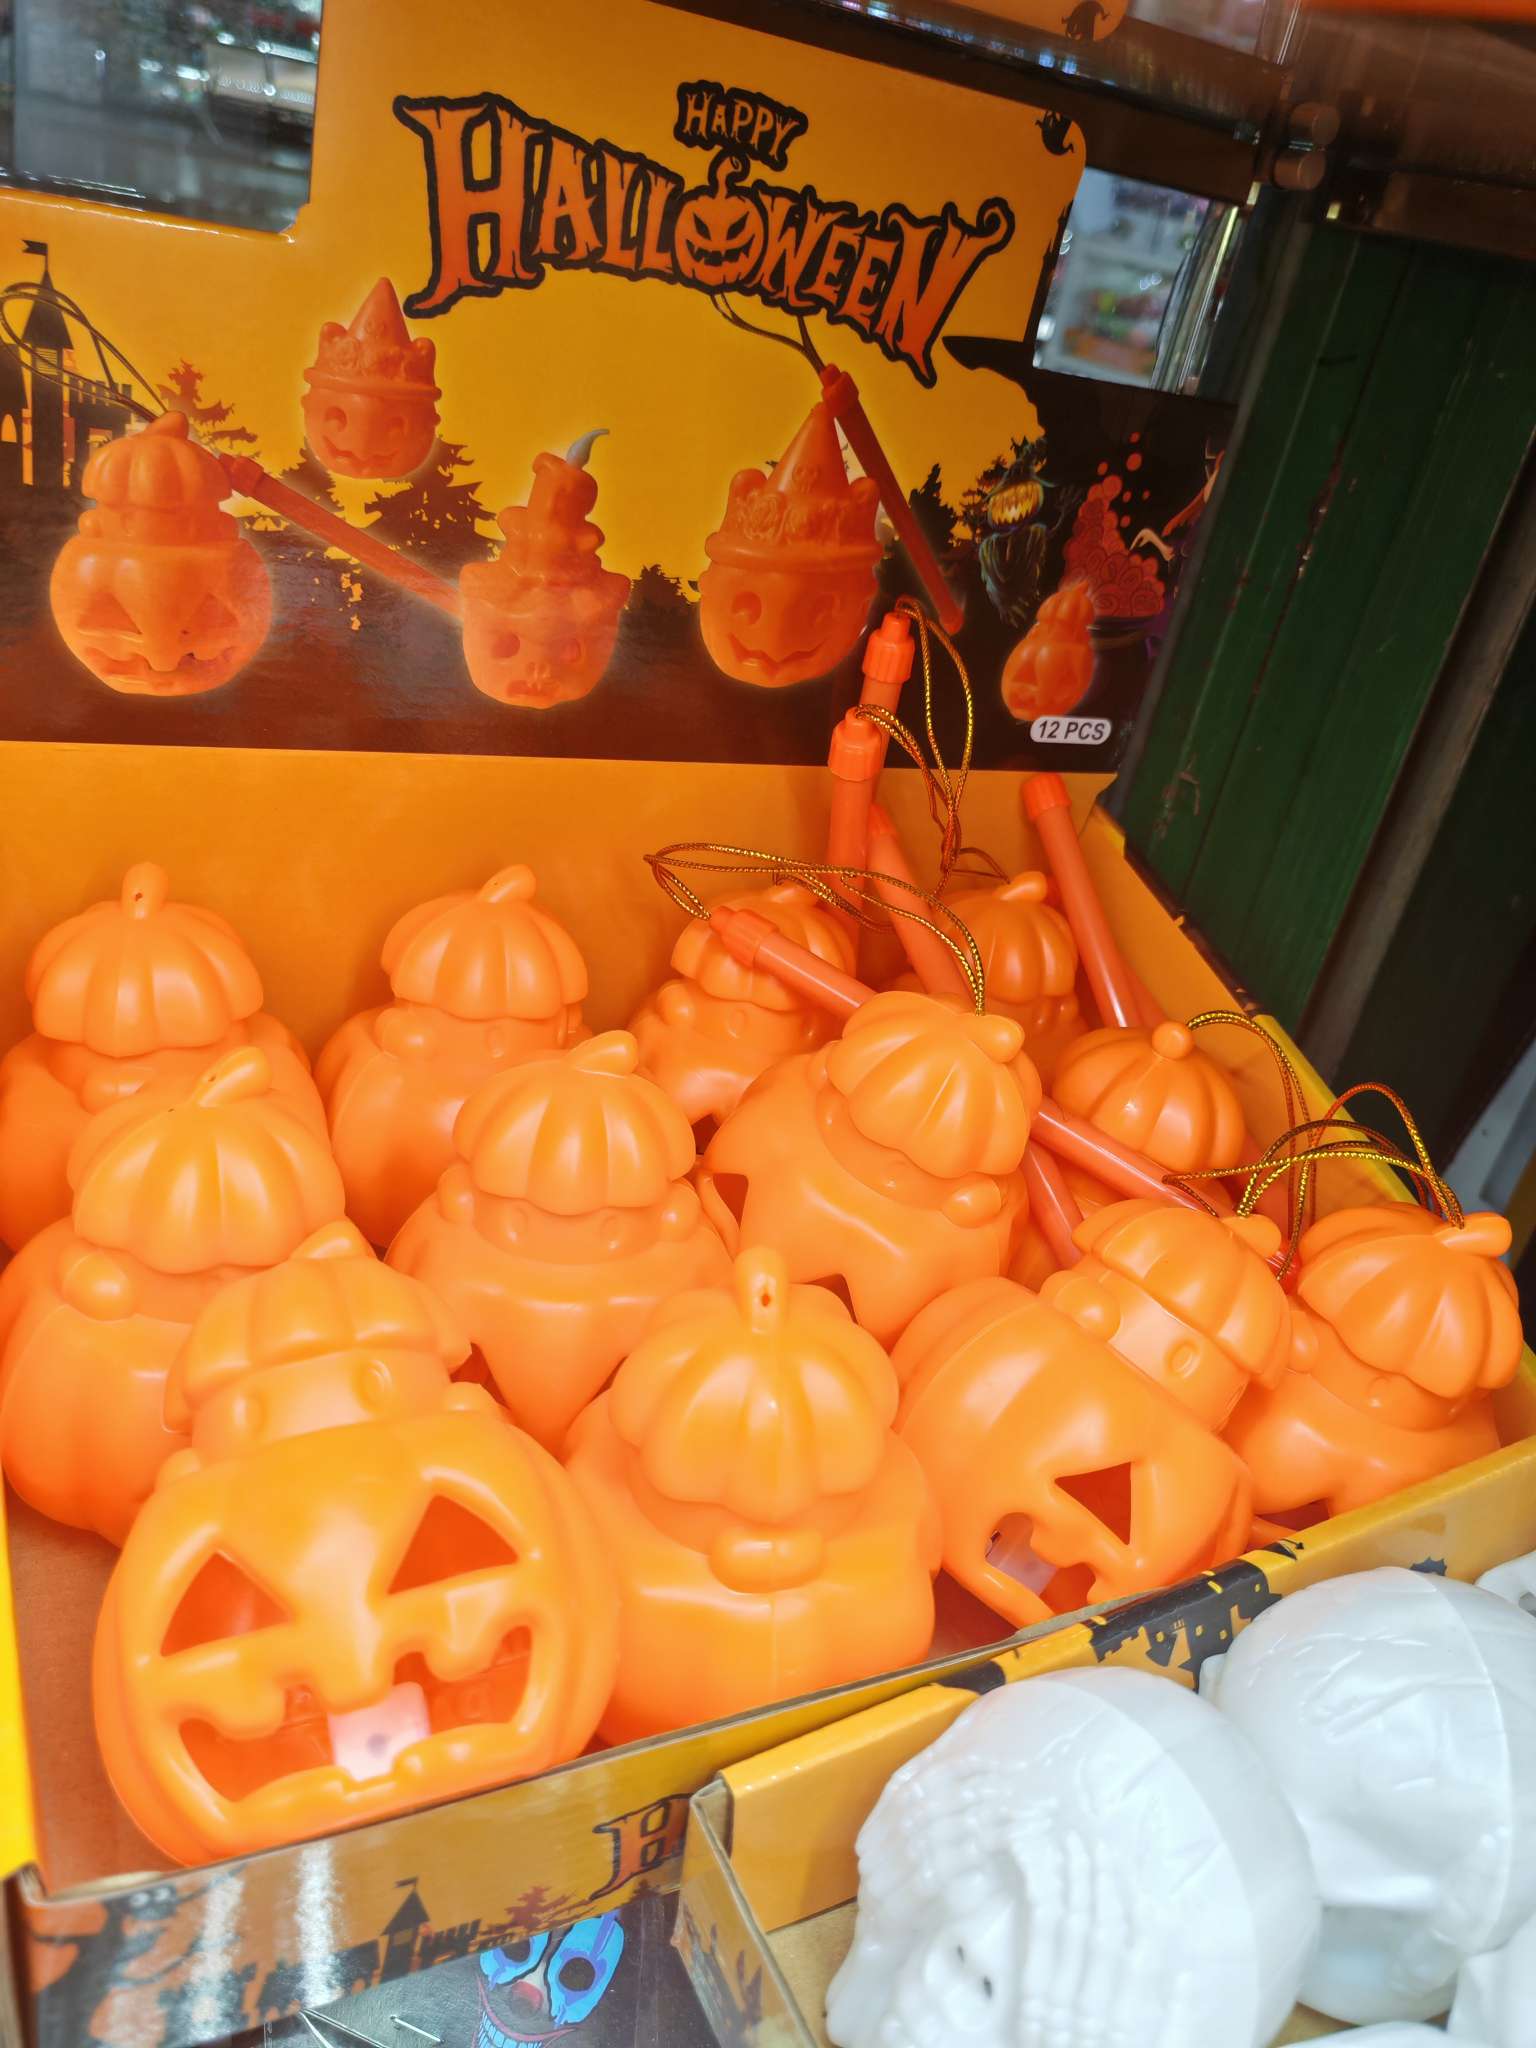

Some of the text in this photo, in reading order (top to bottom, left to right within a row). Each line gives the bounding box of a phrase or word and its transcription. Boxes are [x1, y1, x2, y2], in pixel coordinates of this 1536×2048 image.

[677, 83, 806, 168] HAPPY
[394, 92, 1014, 388] HALLOWEEN
[1039, 720, 1105, 741] 12 PCS
